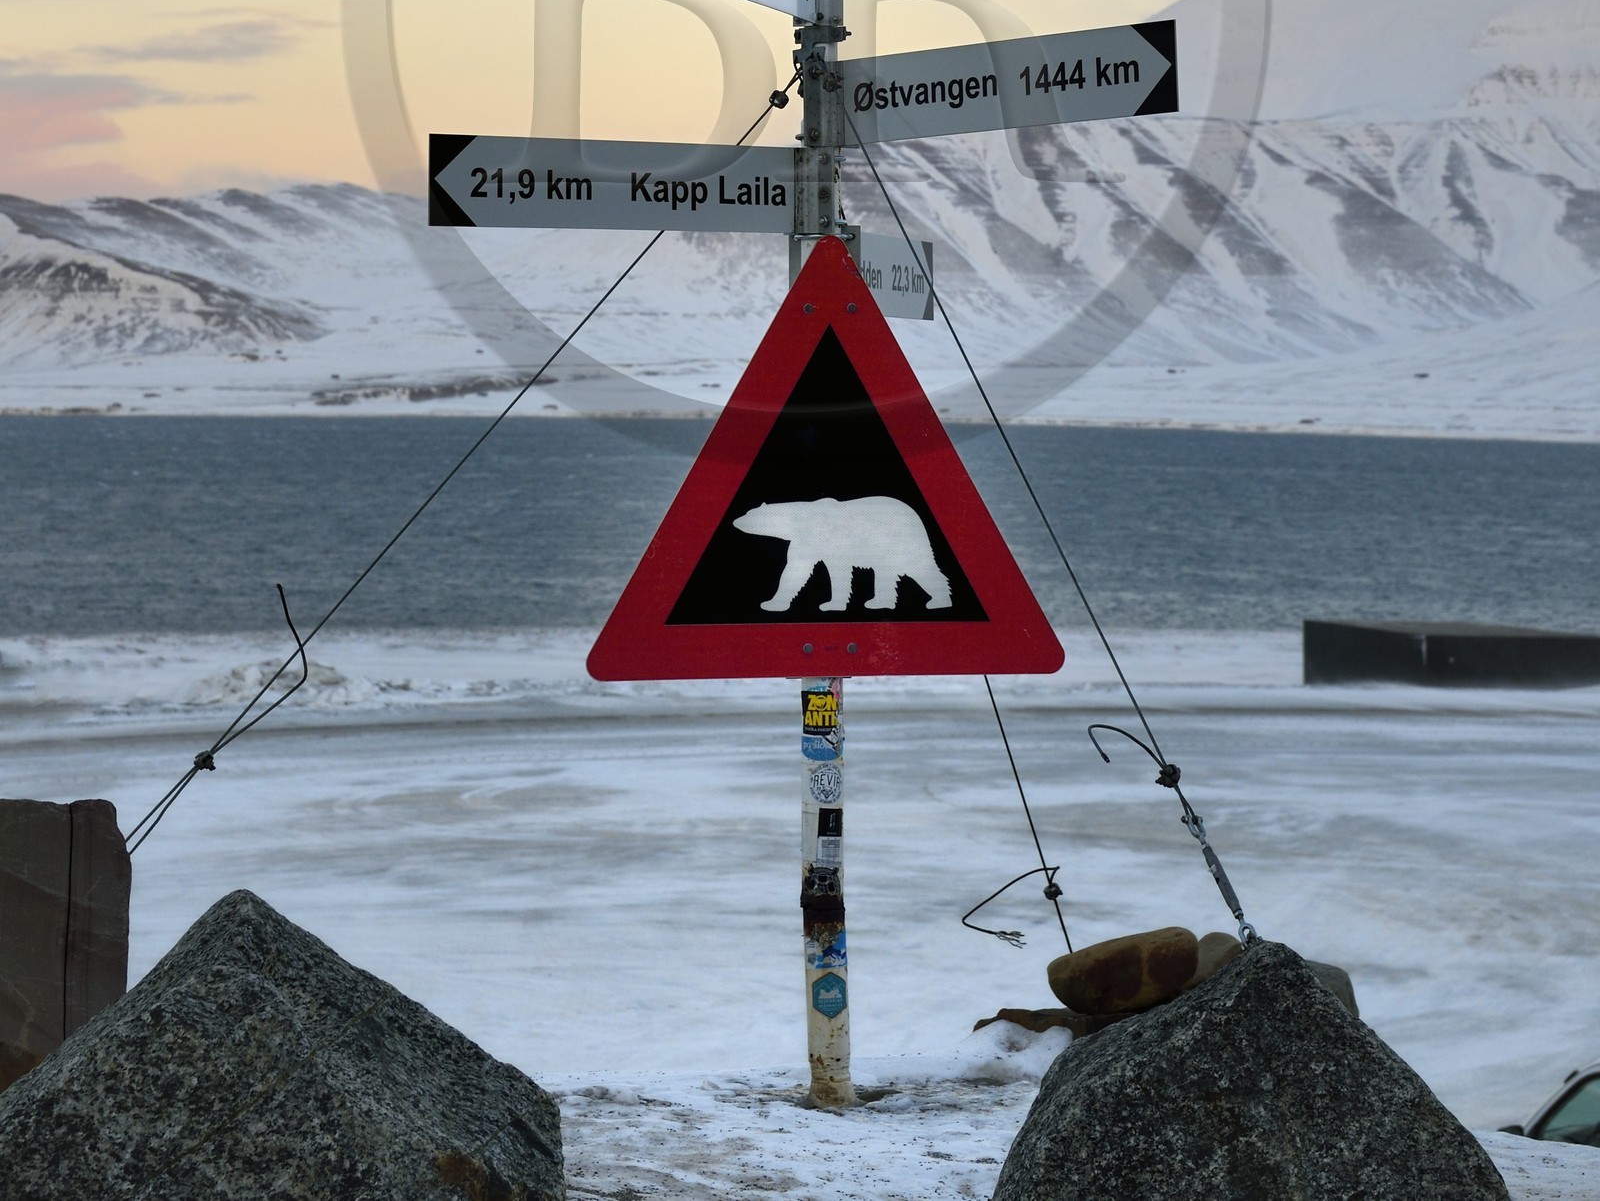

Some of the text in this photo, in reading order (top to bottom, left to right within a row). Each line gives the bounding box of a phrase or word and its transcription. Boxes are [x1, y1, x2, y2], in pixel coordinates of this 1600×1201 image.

[853, 56, 1140, 114] Østvangen 1444 km
[470, 167, 787, 211] 21,9 km Kapp Laila
[891, 264, 910, 297] 22,3
[911, 266, 925, 294] km
